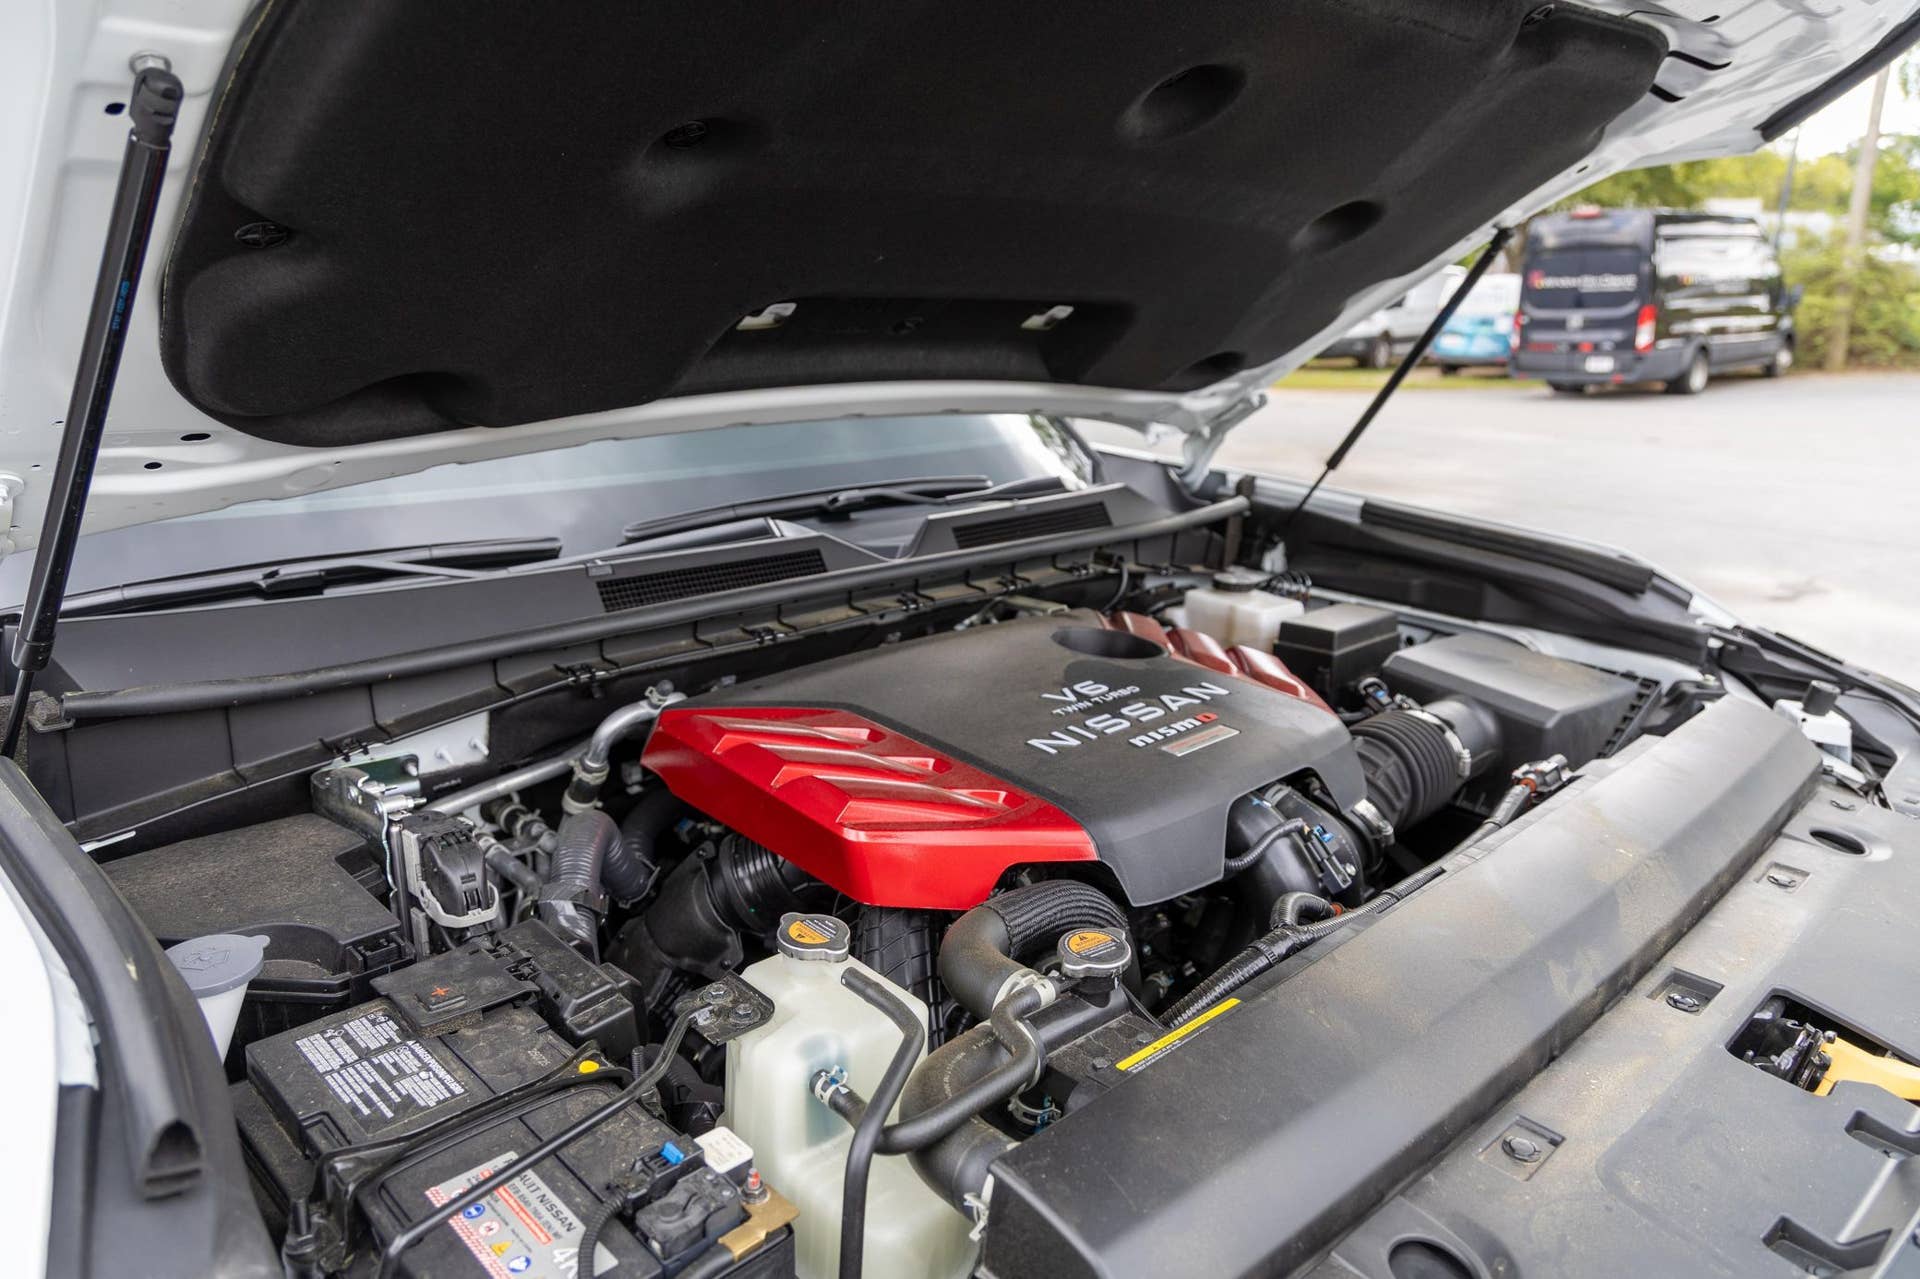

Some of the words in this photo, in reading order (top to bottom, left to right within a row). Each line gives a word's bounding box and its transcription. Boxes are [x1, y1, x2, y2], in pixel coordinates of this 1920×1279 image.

[1041, 680, 1109, 702] V6
[1052, 700, 1092, 716] TWIN
[1092, 685, 1140, 705] TURBO
[1027, 681, 1230, 755] NISSAN
[537, 1194, 577, 1232] NISSAN
